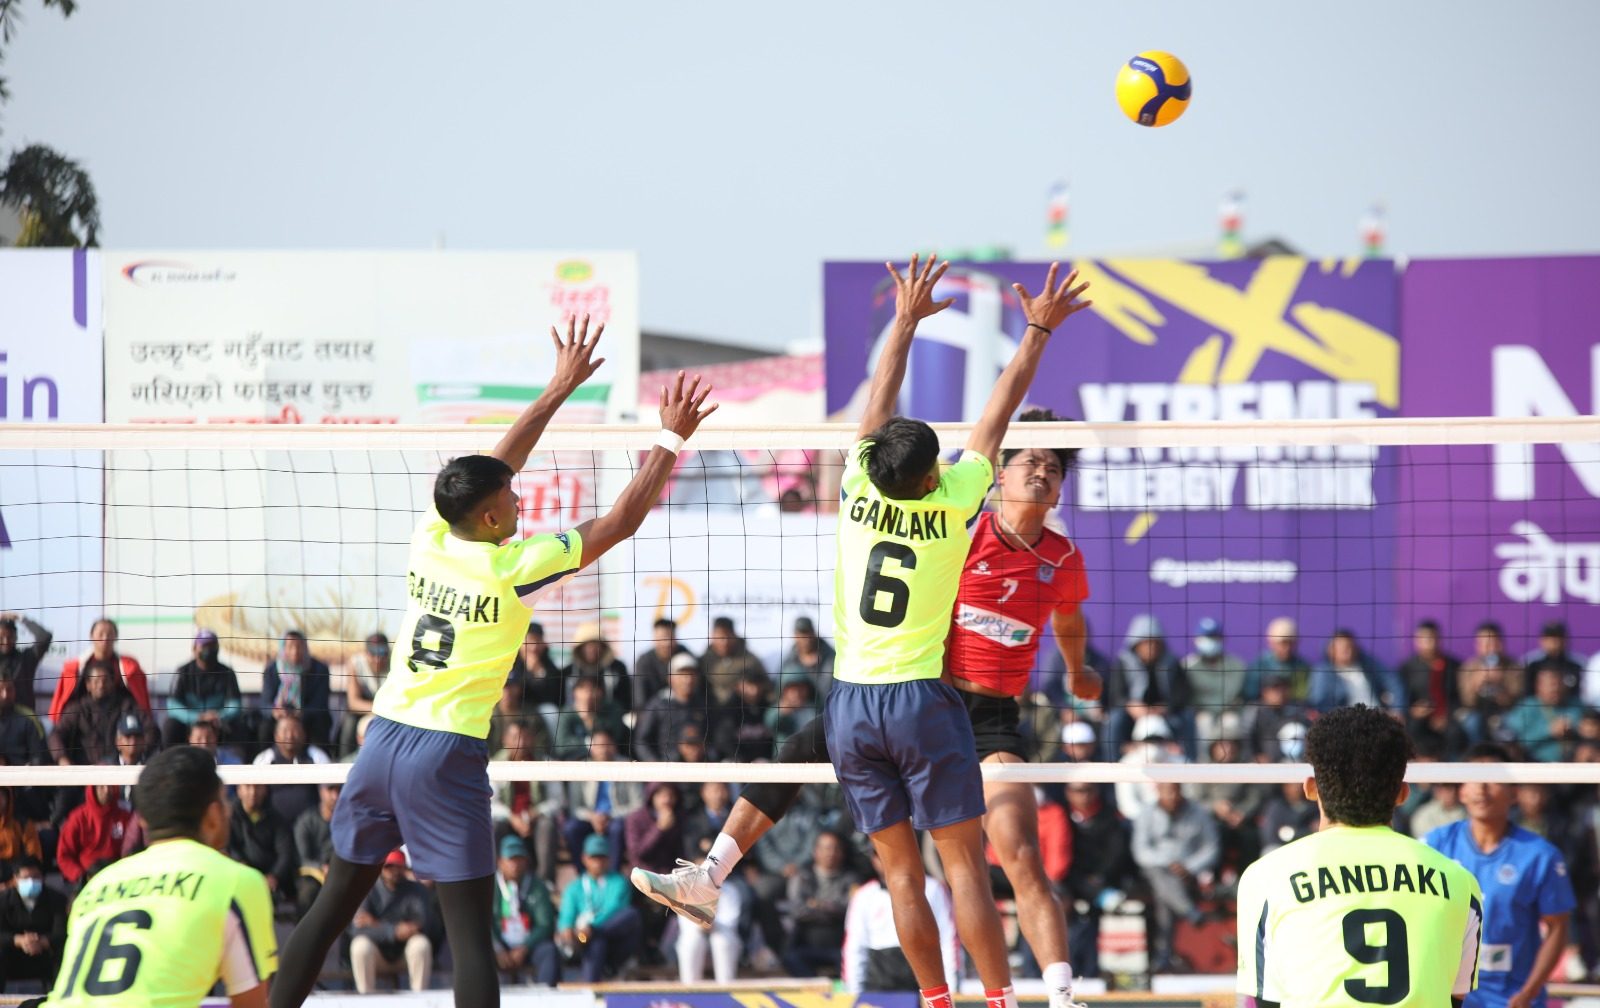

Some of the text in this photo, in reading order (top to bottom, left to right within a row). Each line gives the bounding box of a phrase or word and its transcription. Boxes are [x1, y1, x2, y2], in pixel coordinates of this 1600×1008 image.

[850, 496, 948, 541] GANDAKI
[859, 541, 917, 628] 6
[997, 578, 1019, 604] 7
[80, 872, 204, 917] ANDAKI
[1289, 863, 1450, 904] GANDAKI
[61, 909, 153, 999] 16
[1342, 908, 1410, 1005] 9
